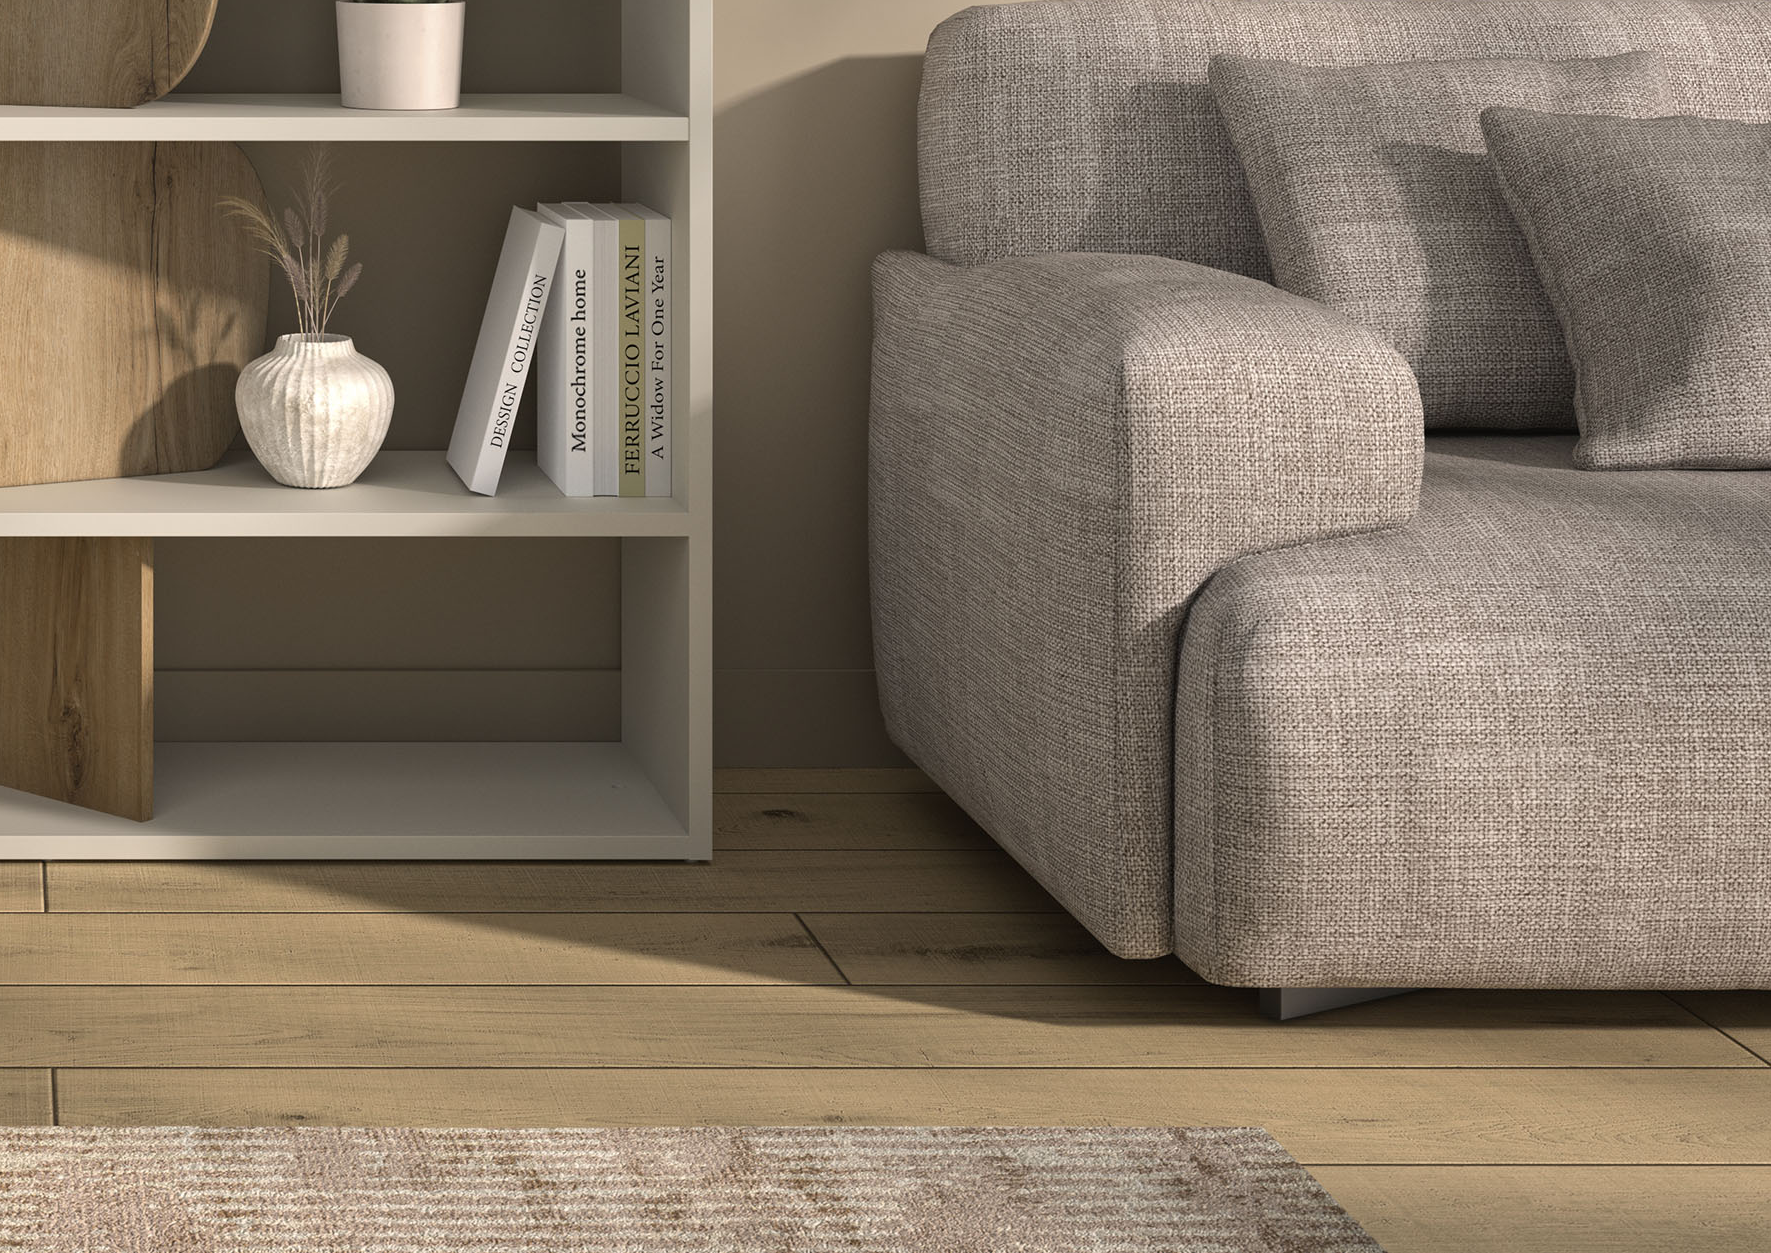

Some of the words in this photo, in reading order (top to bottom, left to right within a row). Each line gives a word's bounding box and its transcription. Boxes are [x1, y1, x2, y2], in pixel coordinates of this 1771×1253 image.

[571, 269, 586, 321] home
[625, 245, 640, 337] LAVIANI
[651, 256, 664, 293] Year
[651, 299, 664, 336] One
[490, 382, 518, 448] DESSIGN
[511, 274, 547, 373] COLLECTION
[651, 341, 664, 371] For
[571, 327, 586, 452] Monochrome
[625, 344, 640, 475] FERRUCCIO
[651, 377, 664, 442] Widow
[651, 445, 664, 459] A
